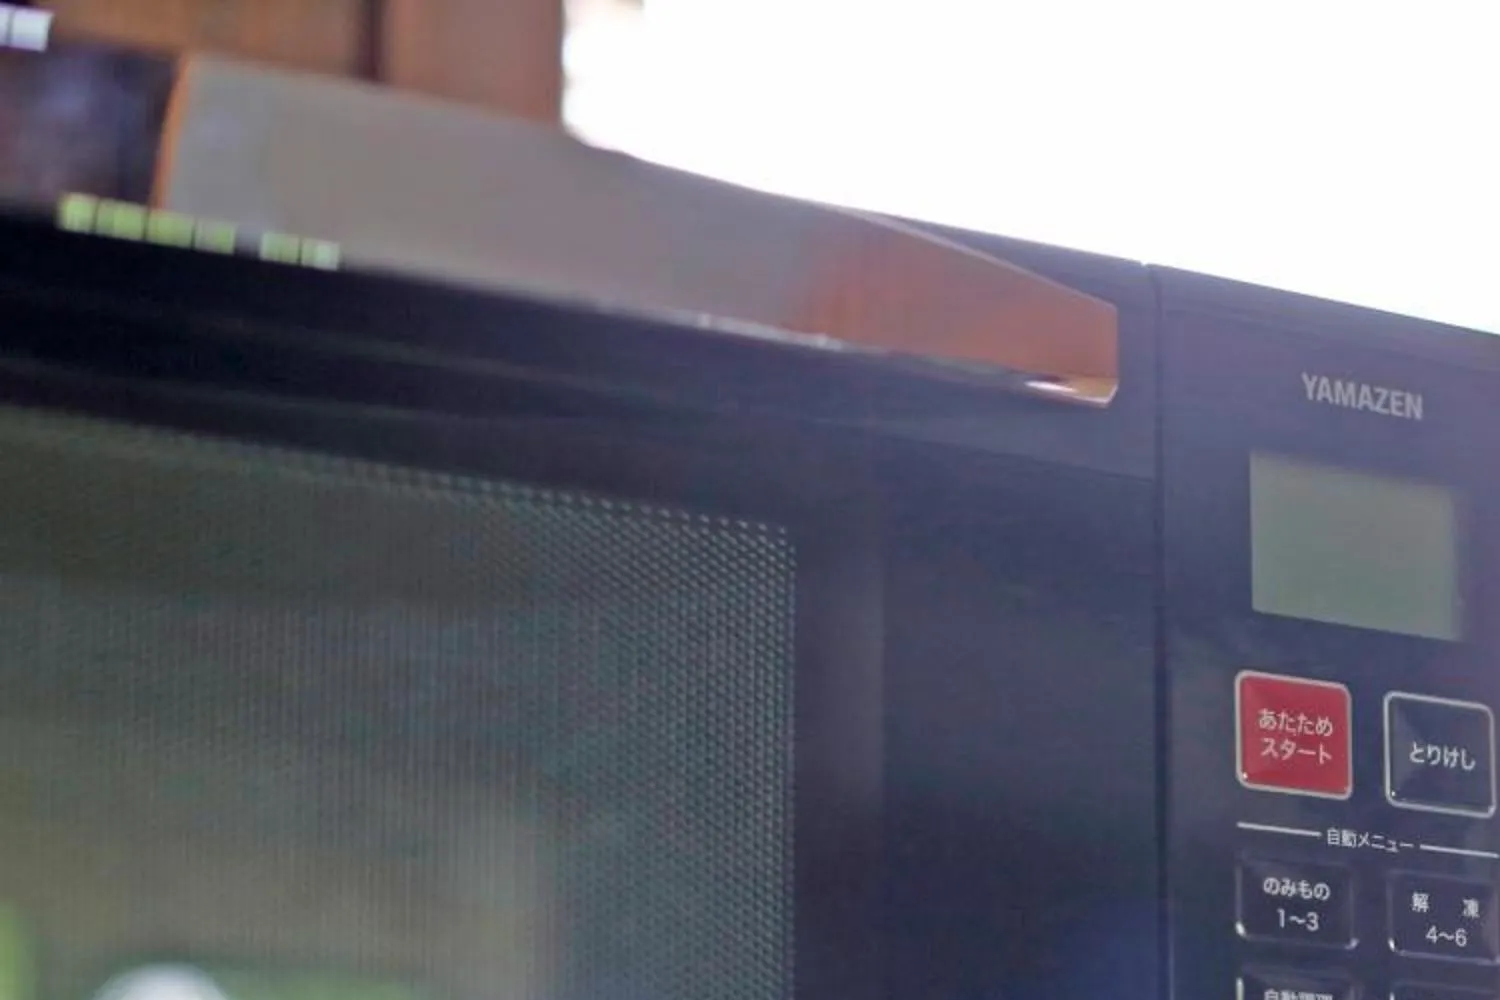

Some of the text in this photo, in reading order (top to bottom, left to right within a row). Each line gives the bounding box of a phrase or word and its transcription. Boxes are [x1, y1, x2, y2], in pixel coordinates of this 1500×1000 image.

[1302, 371, 1423, 420] YAMAZEN
[1258, 708, 1333, 737] あたため
[1260, 737, 1332, 764] スタート
[1409, 742, 1476, 771] とりけし
[1327, 828, 1414, 852] 自動メニュー
[1263, 876, 1331, 901] のみもの
[1277, 908, 1319, 932] 1～3
[1425, 925, 1467, 947] 4～6
